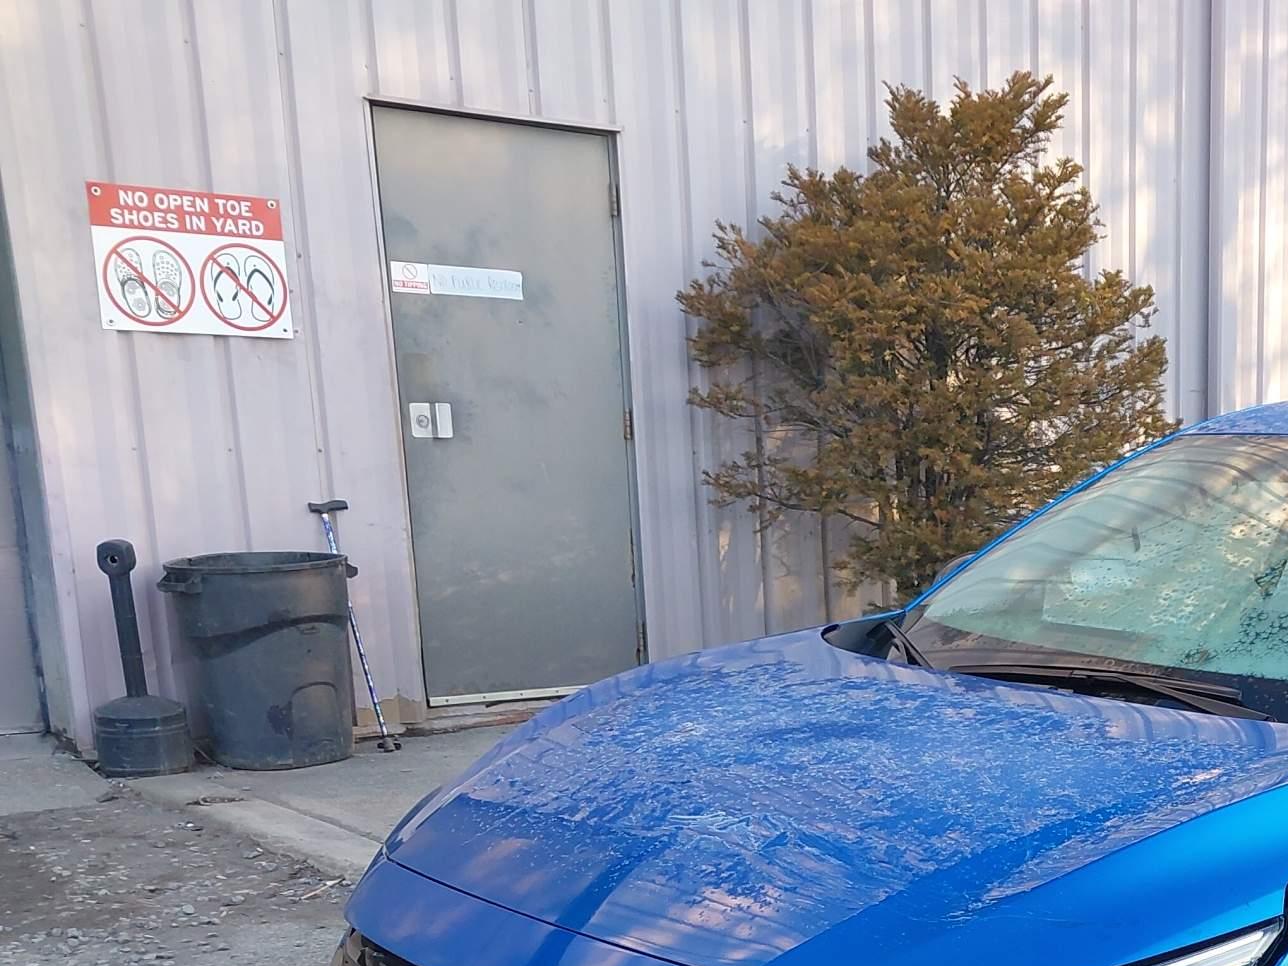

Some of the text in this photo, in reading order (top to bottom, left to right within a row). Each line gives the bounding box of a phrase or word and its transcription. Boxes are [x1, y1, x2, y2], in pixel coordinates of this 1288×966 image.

[118, 189, 253, 217] NO OPEN TOE
[110, 208, 264, 236] SHOES IN YARD
